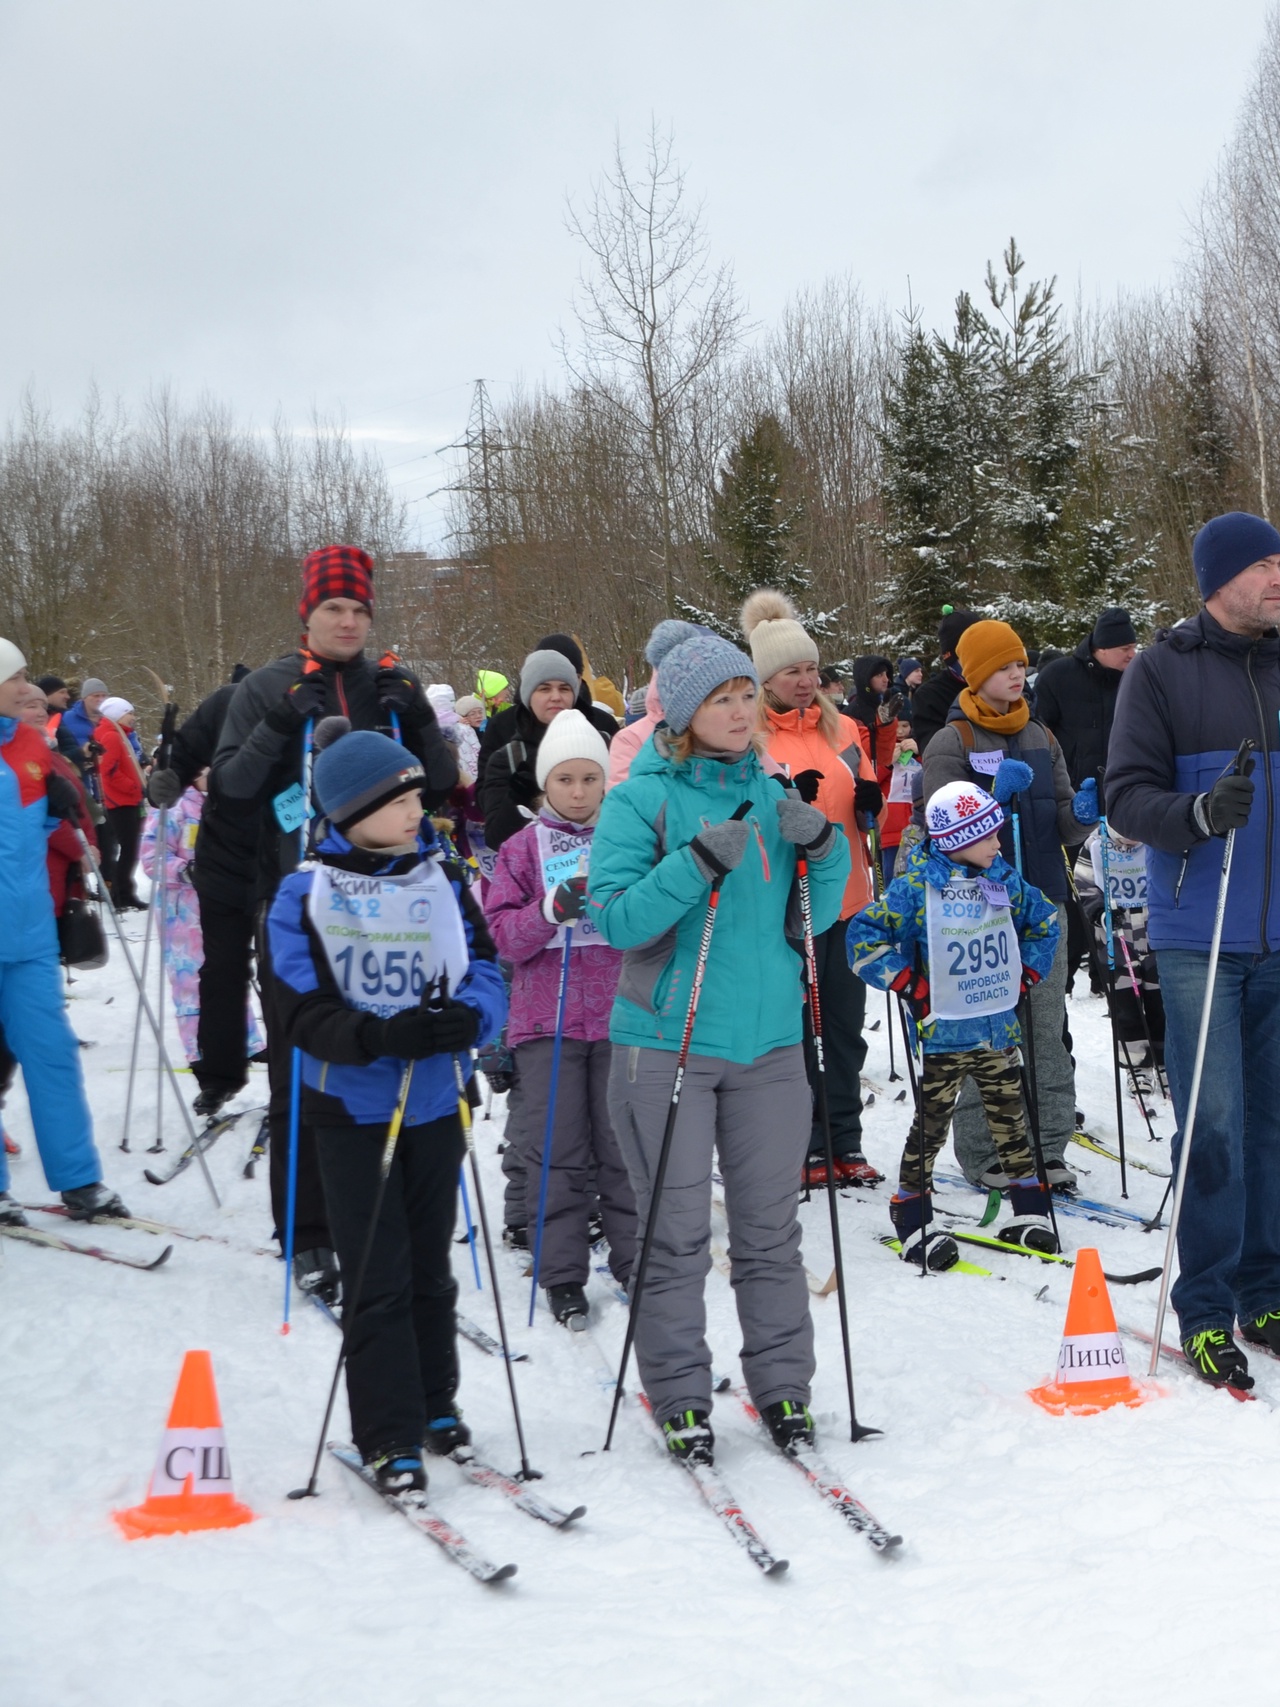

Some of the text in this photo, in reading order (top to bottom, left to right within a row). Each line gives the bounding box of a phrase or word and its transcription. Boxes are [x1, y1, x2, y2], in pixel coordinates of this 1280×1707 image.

[552, 837, 592, 853] РОССИ
[548, 876, 555, 886] 9
[982, 884, 1005, 893] ЕМЬЯ
[1109, 876, 1147, 899] 292
[942, 903, 981, 918] 2022
[947, 931, 1009, 976] 2950
[336, 945, 427, 998] 1956
[958, 971, 1011, 991] КИРОВСКАЯ
[965, 986, 1009, 1004] ОБЛАСТЬ
